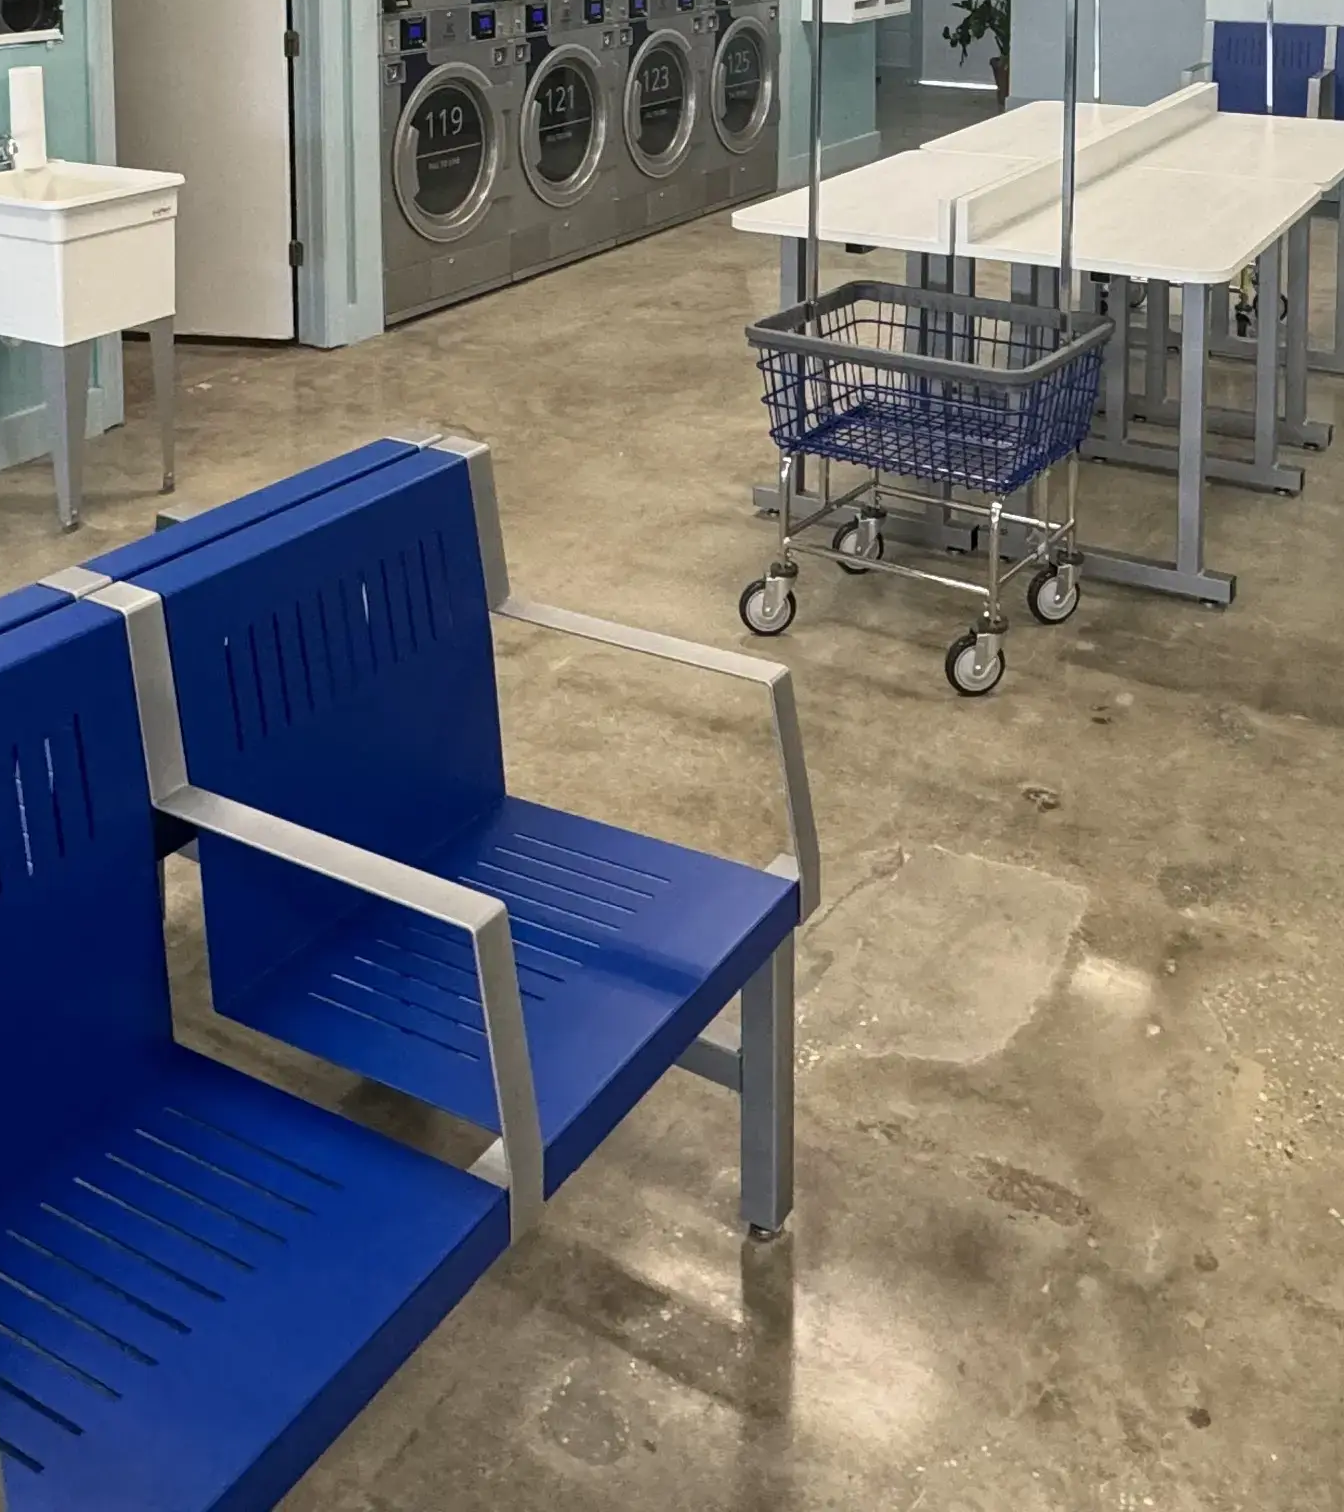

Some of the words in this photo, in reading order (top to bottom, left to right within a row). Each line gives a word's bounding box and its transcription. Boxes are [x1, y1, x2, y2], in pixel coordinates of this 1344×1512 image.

[727, 50, 751, 75] 125
[642, 65, 670, 93] 123
[545, 84, 575, 115] 121
[425, 106, 464, 140] 119
